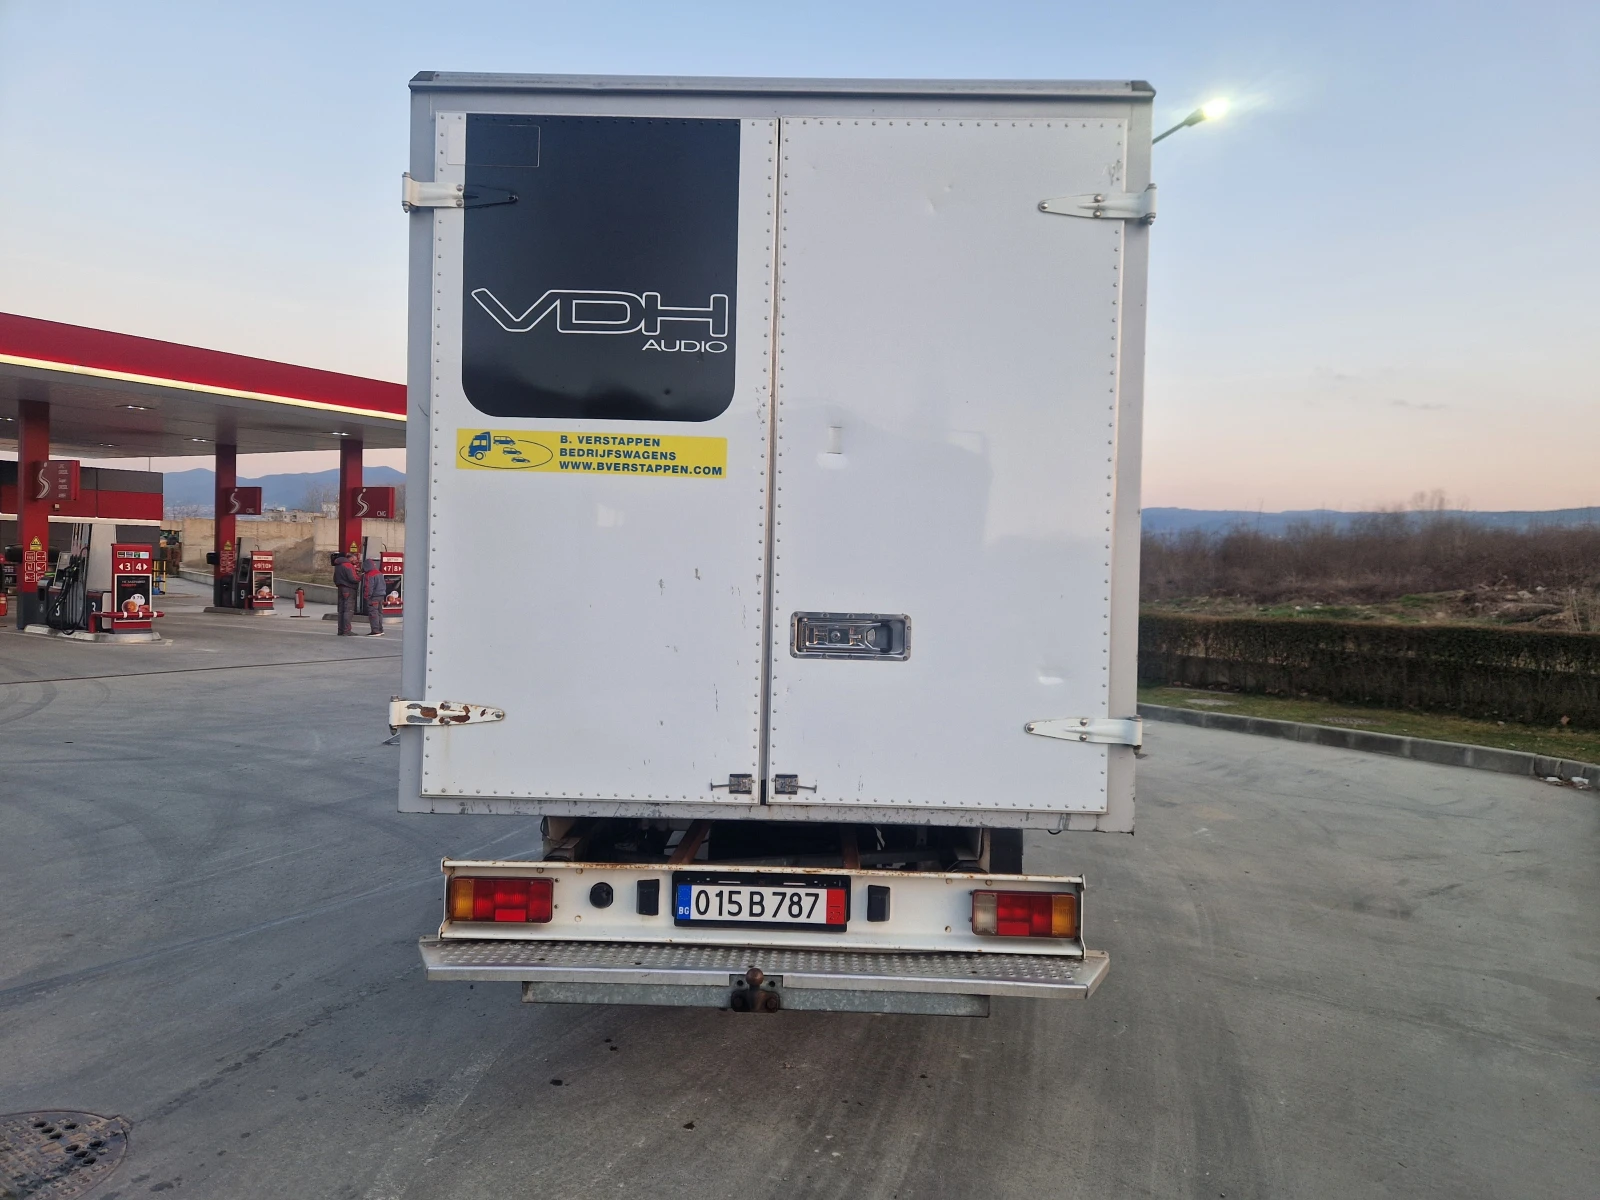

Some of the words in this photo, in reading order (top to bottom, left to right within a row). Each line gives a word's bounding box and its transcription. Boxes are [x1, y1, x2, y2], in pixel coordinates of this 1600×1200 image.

[471, 288, 729, 338] VDH
[641, 340, 728, 353] AUDIO
[560, 435, 572, 444] B.
[577, 435, 661, 447] VERSTAPPEN
[559, 448, 677, 461] BEDRIJFSWAGENS
[559, 461, 723, 476] WWW.BVERSTAPPEN.COM
[124, 562, 131, 571] 3
[135, 562, 142, 571] 4
[240, 589, 245, 600] 9
[678, 906, 690, 915] BG
